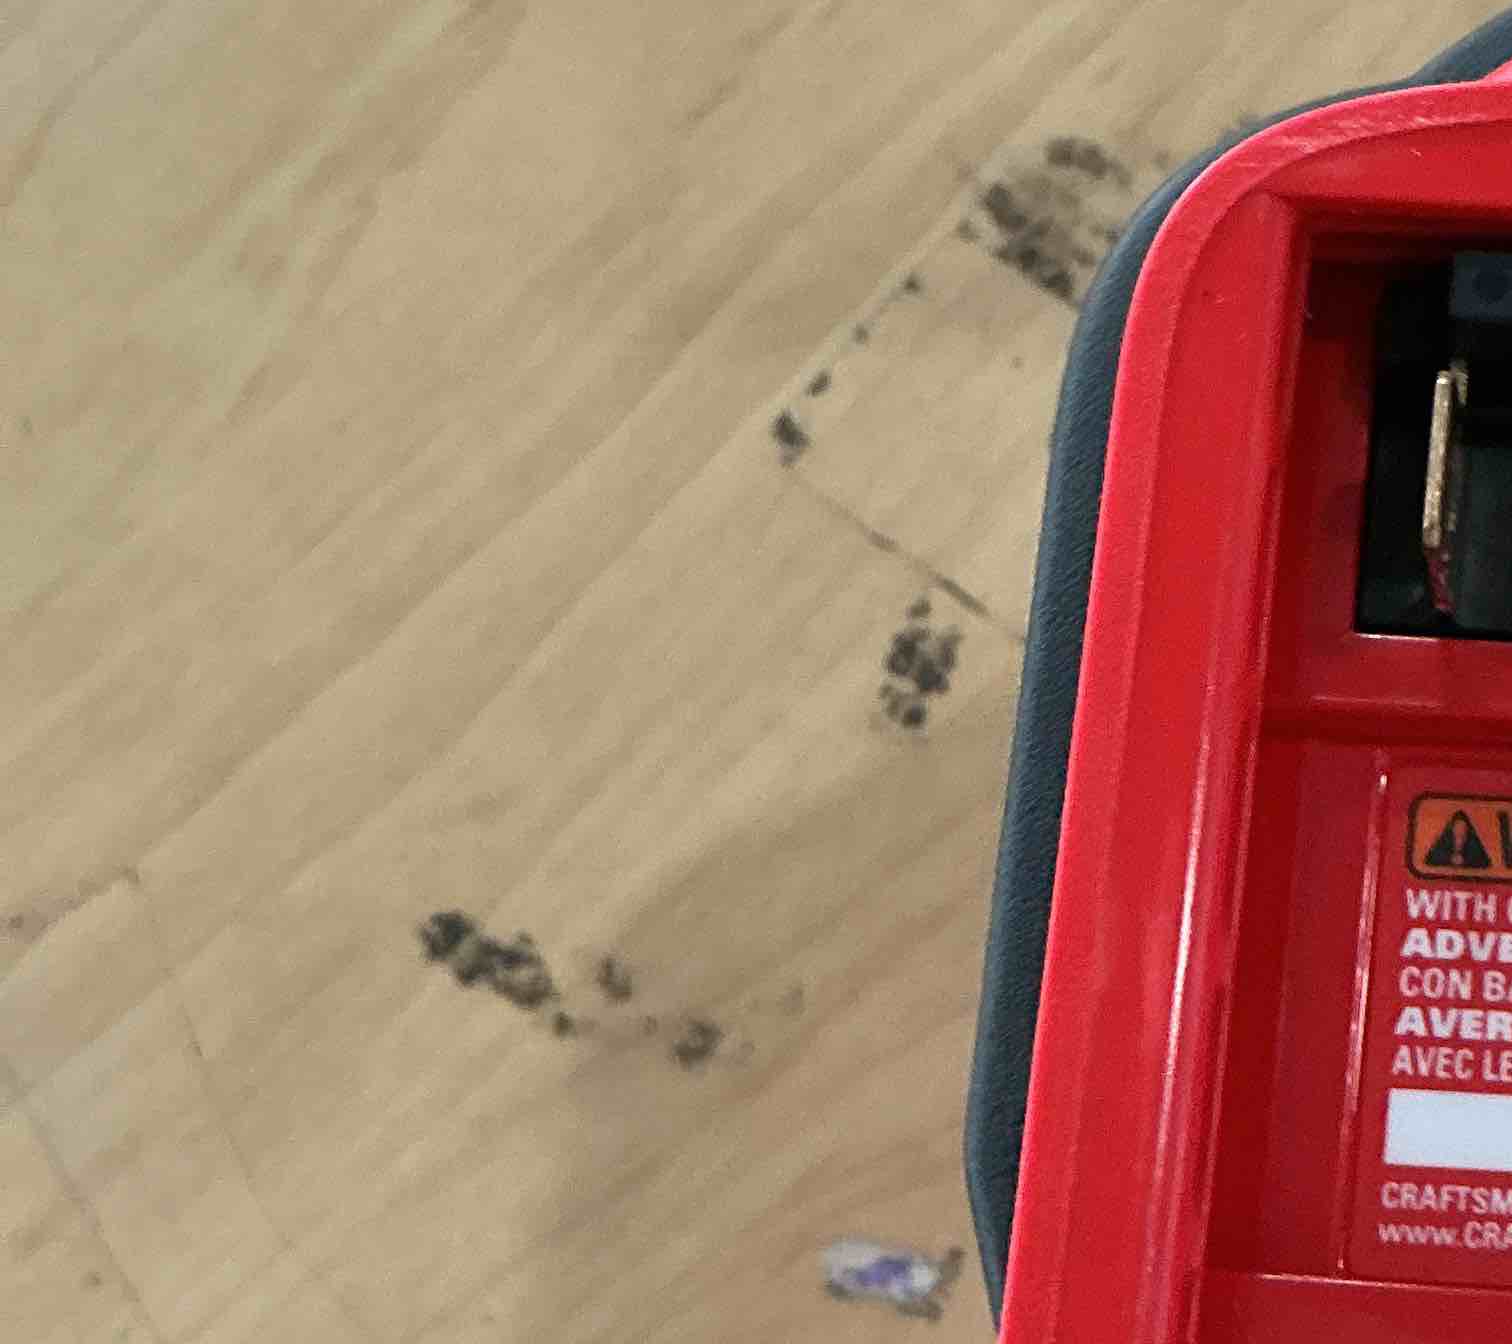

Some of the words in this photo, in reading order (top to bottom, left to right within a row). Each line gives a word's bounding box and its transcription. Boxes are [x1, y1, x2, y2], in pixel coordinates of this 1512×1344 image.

[1406, 888, 1497, 923] WITH
[1399, 966, 1472, 1000] CON
[1392, 1045, 1474, 1080] AVEC
